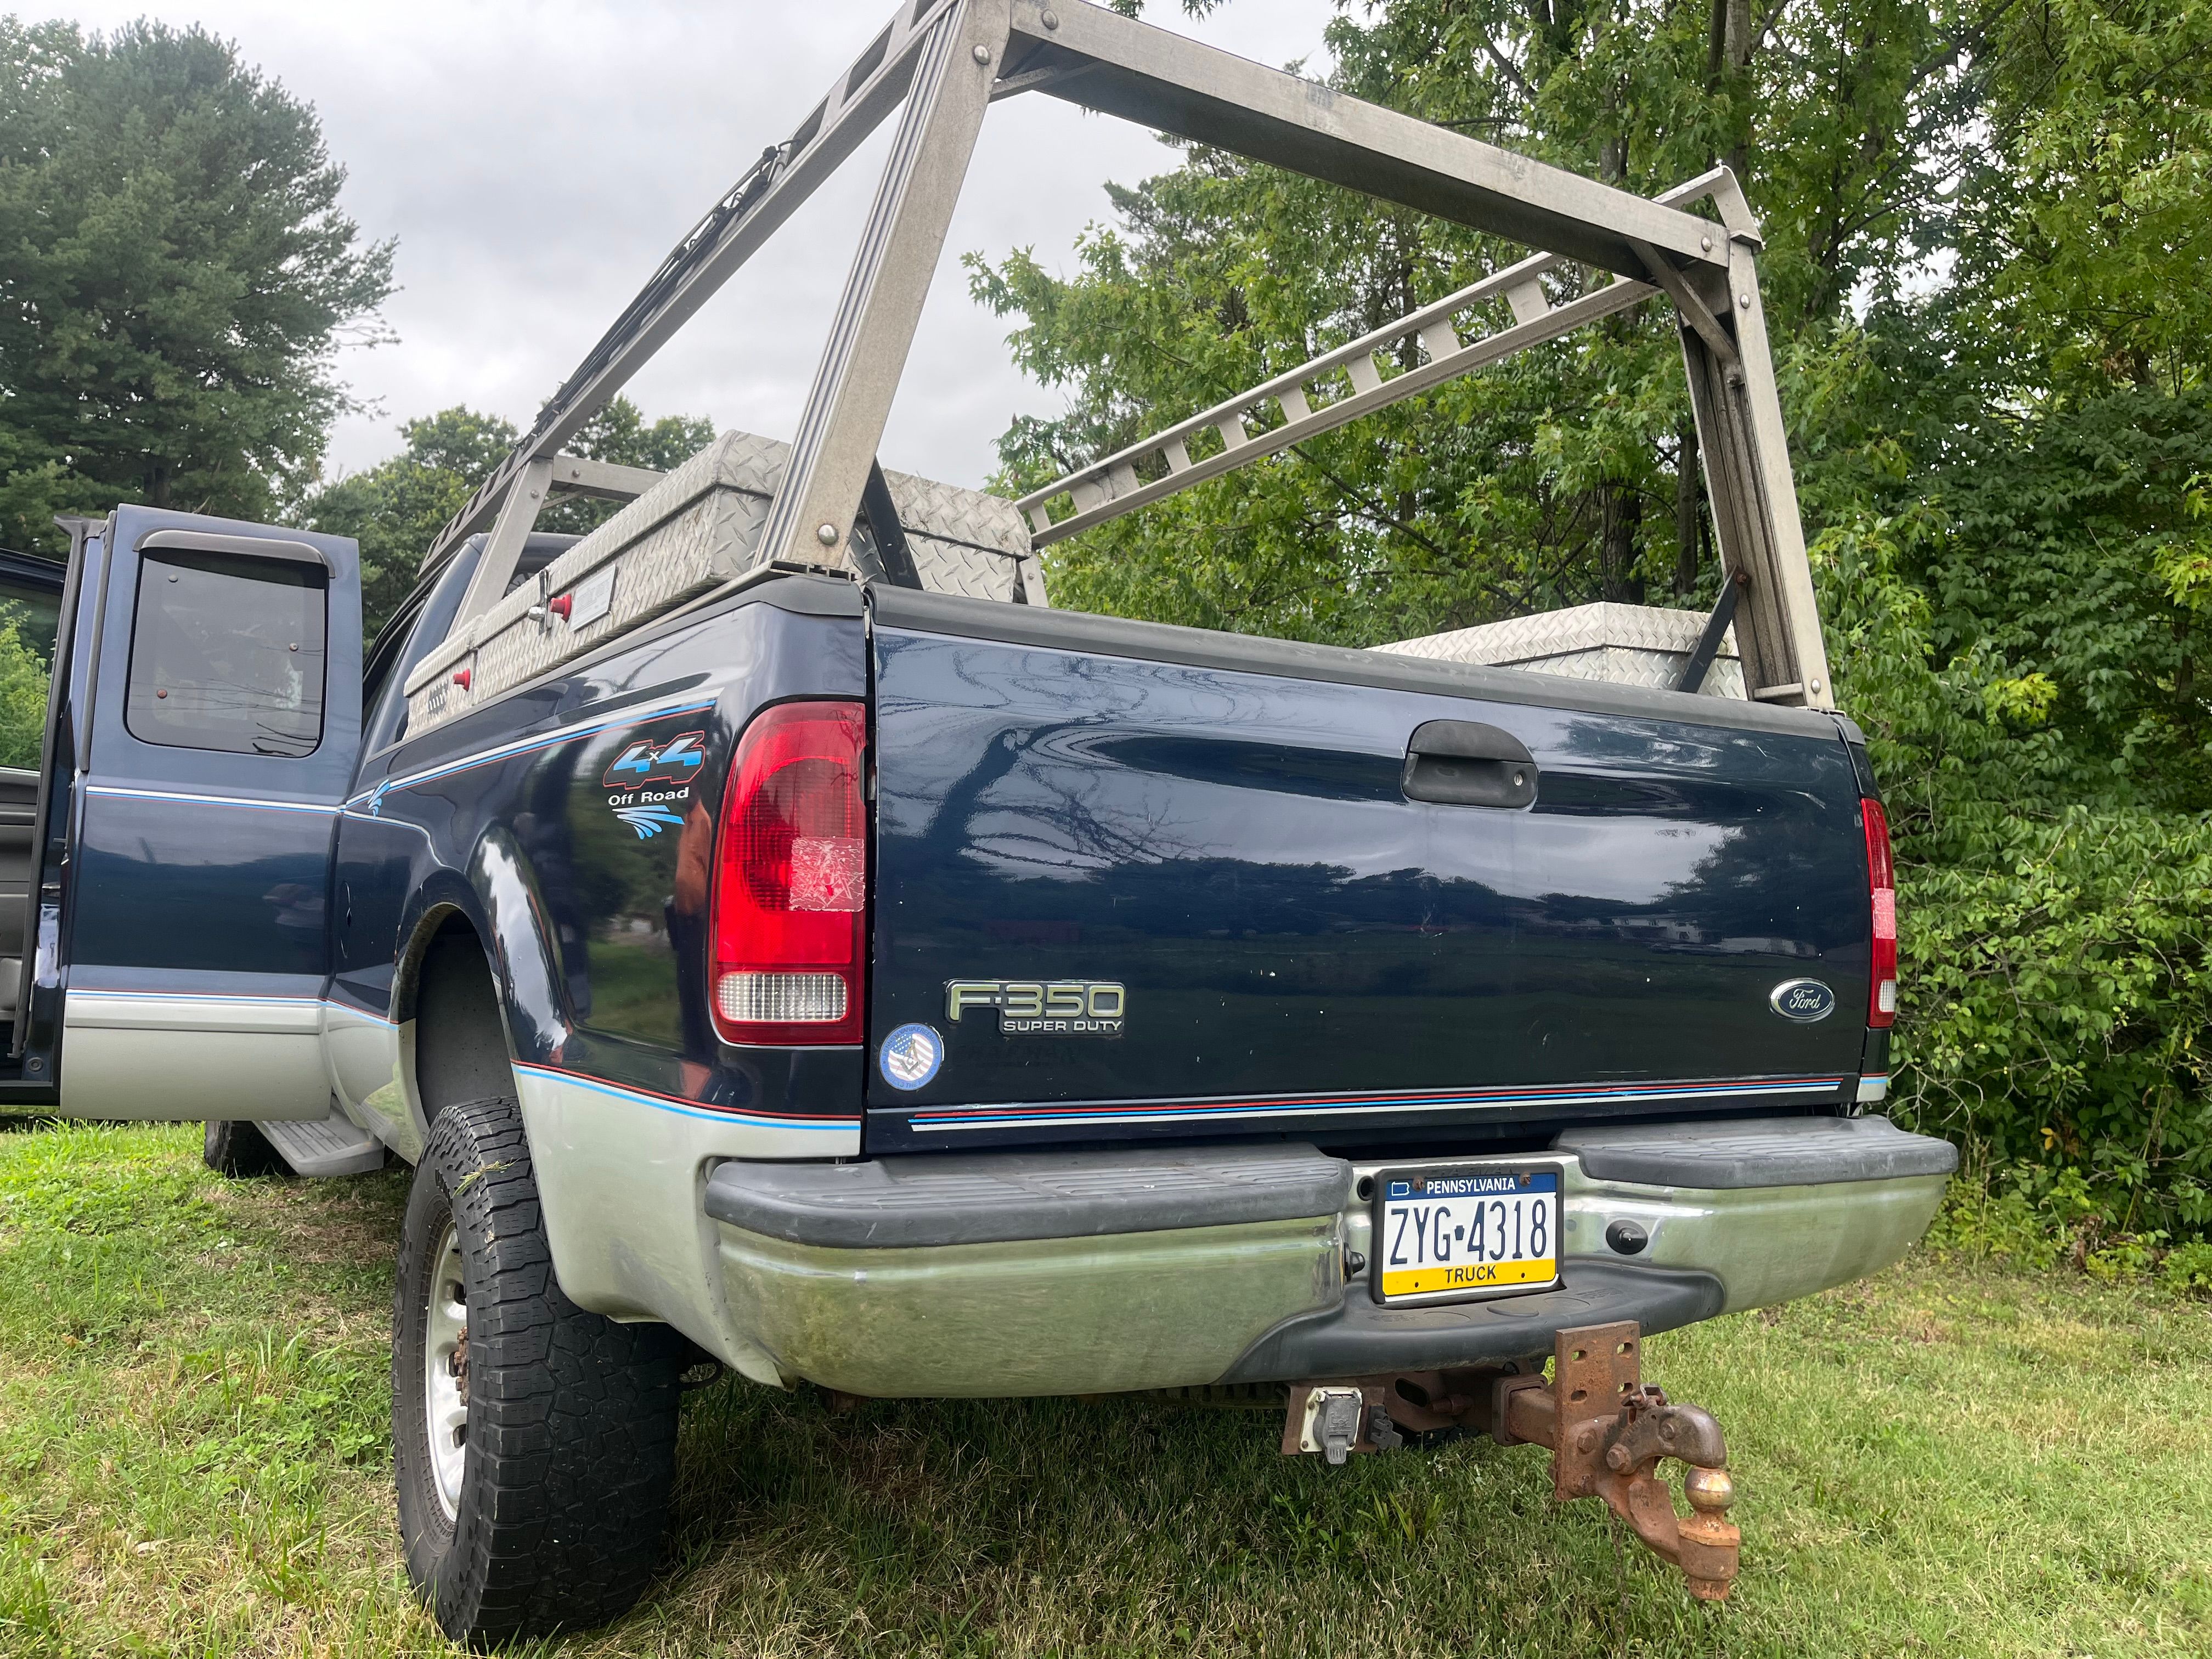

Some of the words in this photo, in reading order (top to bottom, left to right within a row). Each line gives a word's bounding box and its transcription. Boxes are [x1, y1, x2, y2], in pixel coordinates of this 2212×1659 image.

[608, 733, 704, 780] 4x4
[608, 794, 634, 805] Off
[641, 787, 689, 802] Road
[1789, 989, 1821, 1009] Ford
[1003, 1021, 1066, 1032] SUPER
[1073, 1020, 1122, 1032] DUTY
[882, 1027, 916, 1056] PENNSYLVANIA
[1426, 1177, 1516, 1194] PENNSYLVANIA
[1444, 1265, 1497, 1284] TRUCK
